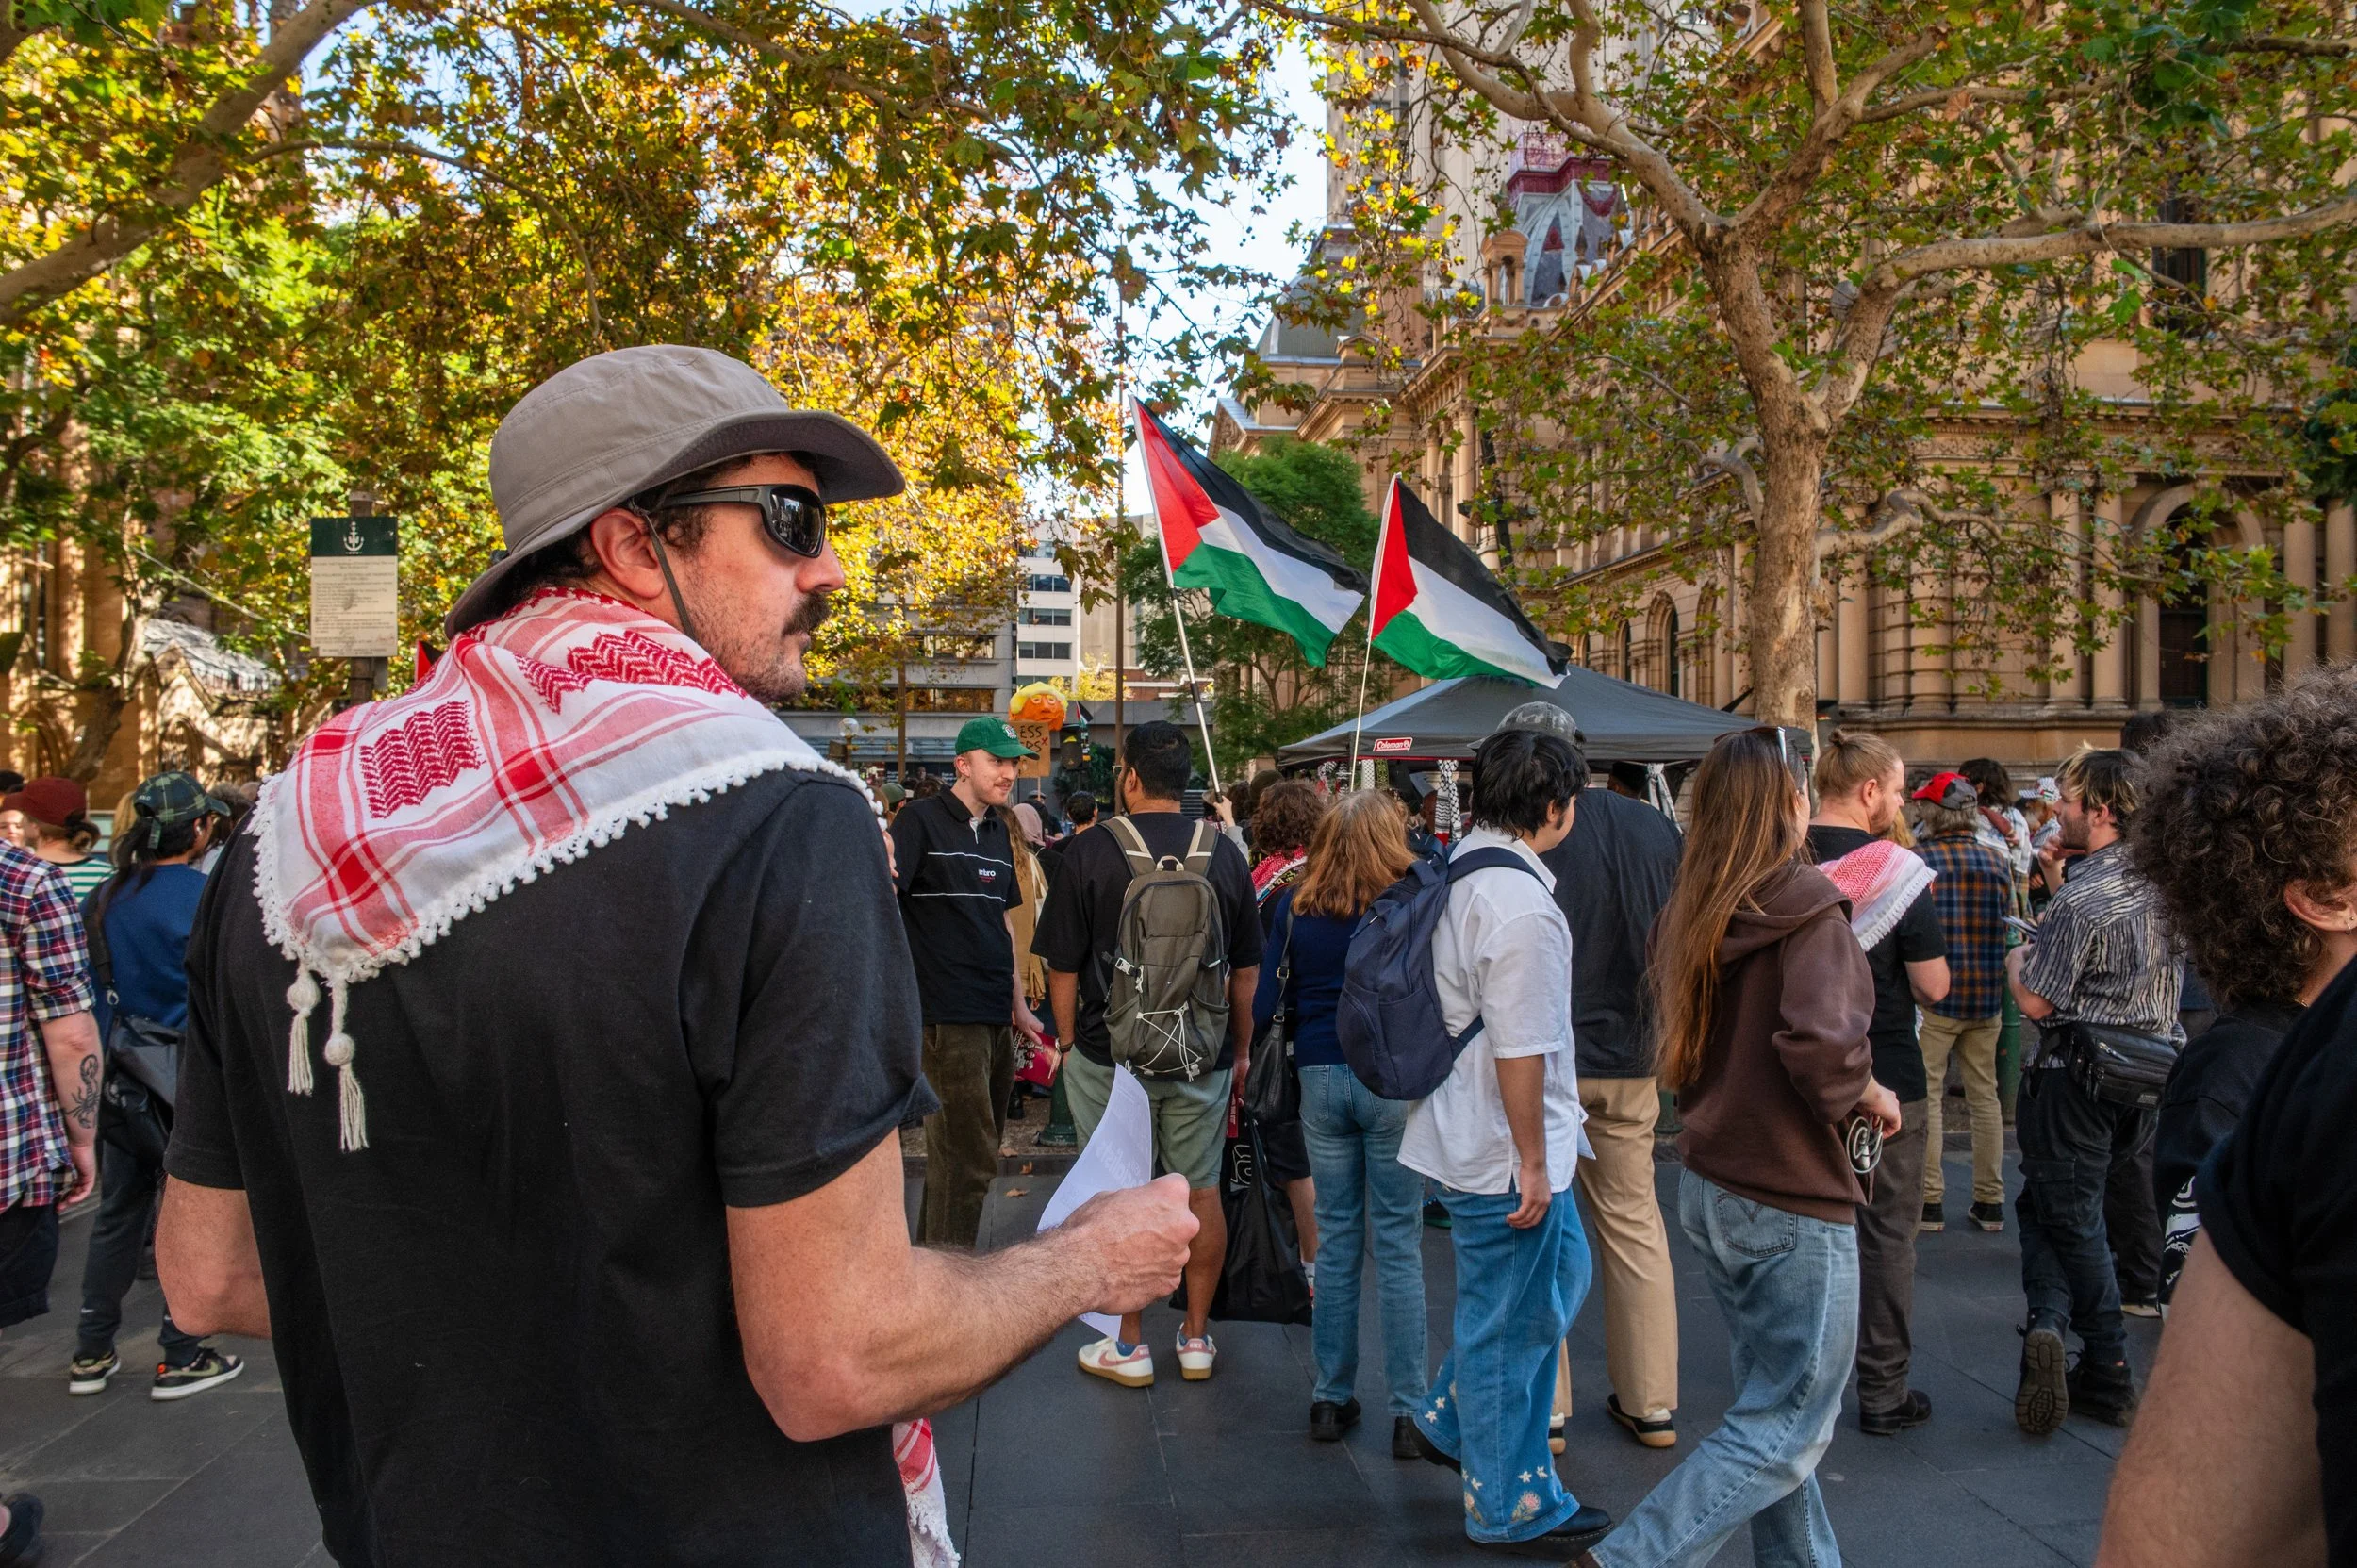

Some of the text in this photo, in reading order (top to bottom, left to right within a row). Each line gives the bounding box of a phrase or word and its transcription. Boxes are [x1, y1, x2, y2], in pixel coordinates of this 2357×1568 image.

[1020, 725, 1043, 738] ESS
[1020, 740, 1042, 753] DS
[1377, 740, 1404, 750] Coleman
